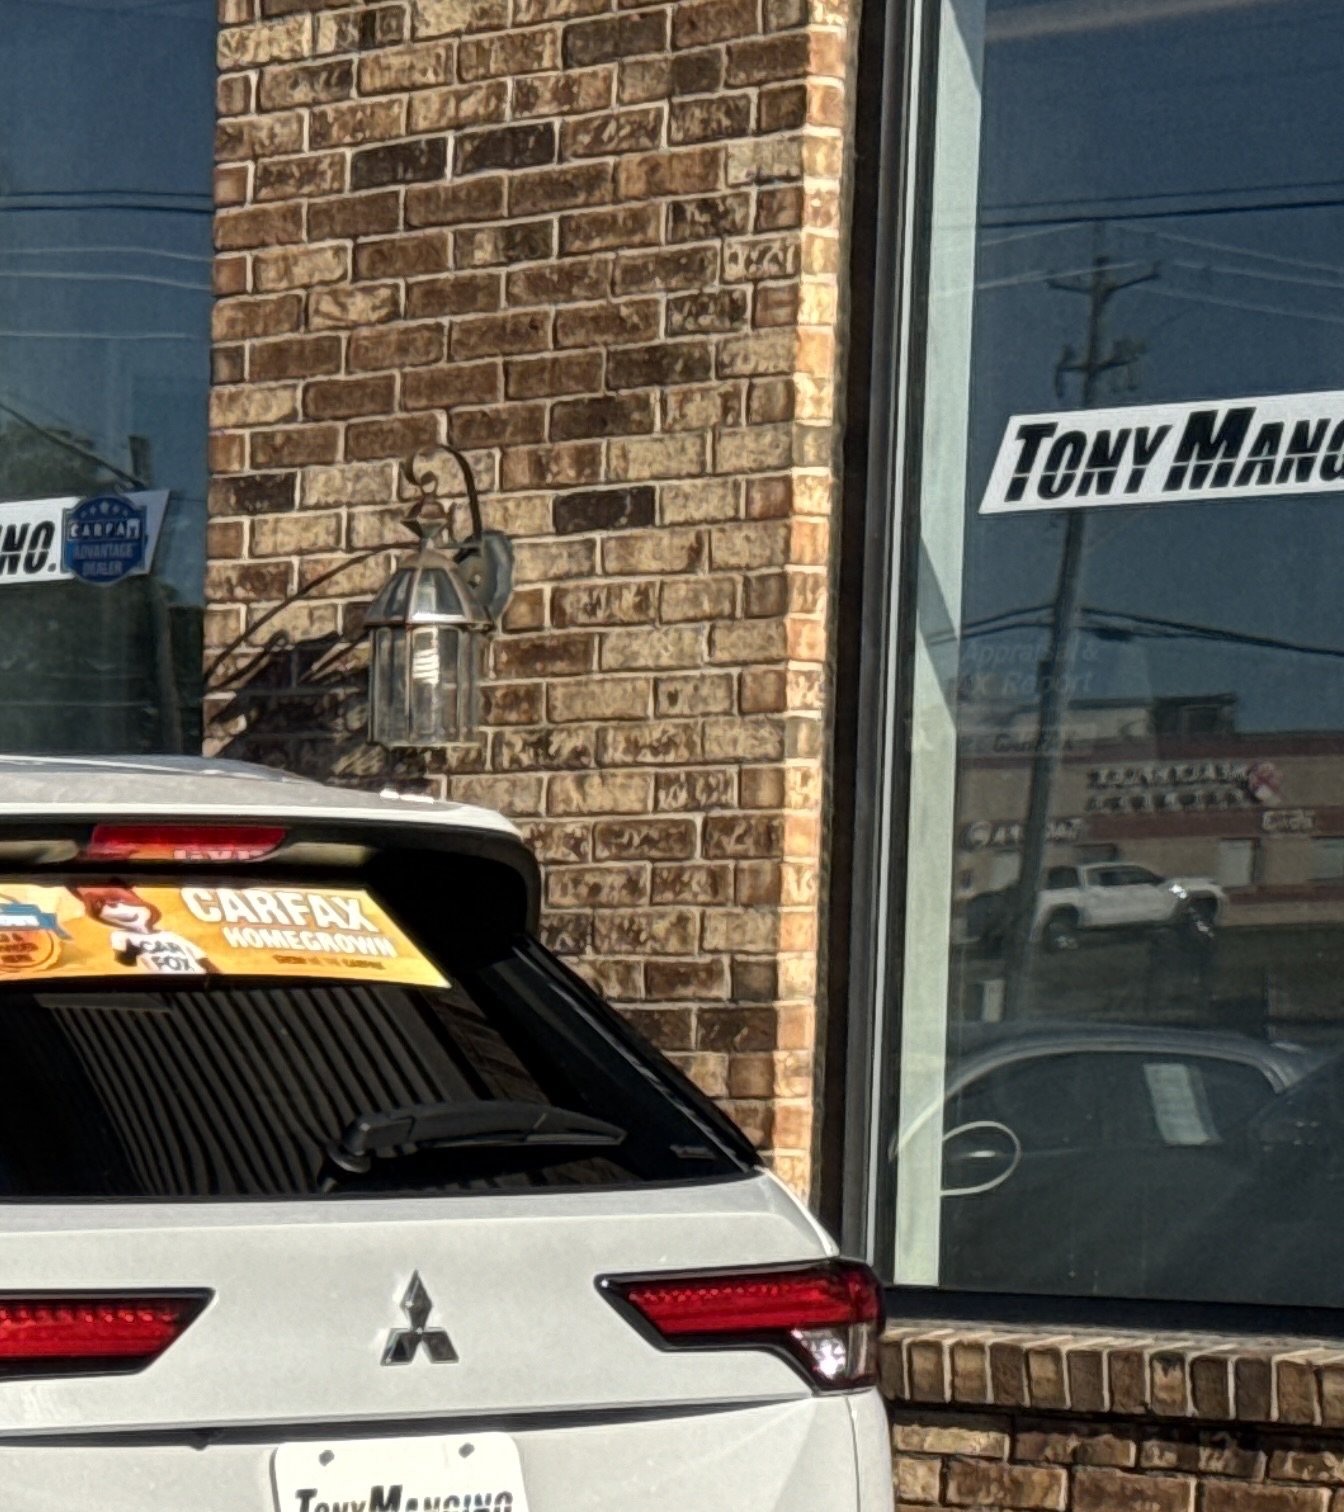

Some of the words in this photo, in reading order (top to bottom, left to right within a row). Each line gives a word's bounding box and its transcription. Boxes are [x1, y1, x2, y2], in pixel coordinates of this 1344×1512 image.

[1004, 421, 1173, 503] TONY
[179, 887, 381, 932] CARFAX
[221, 926, 399, 959] HOMEGROWN
